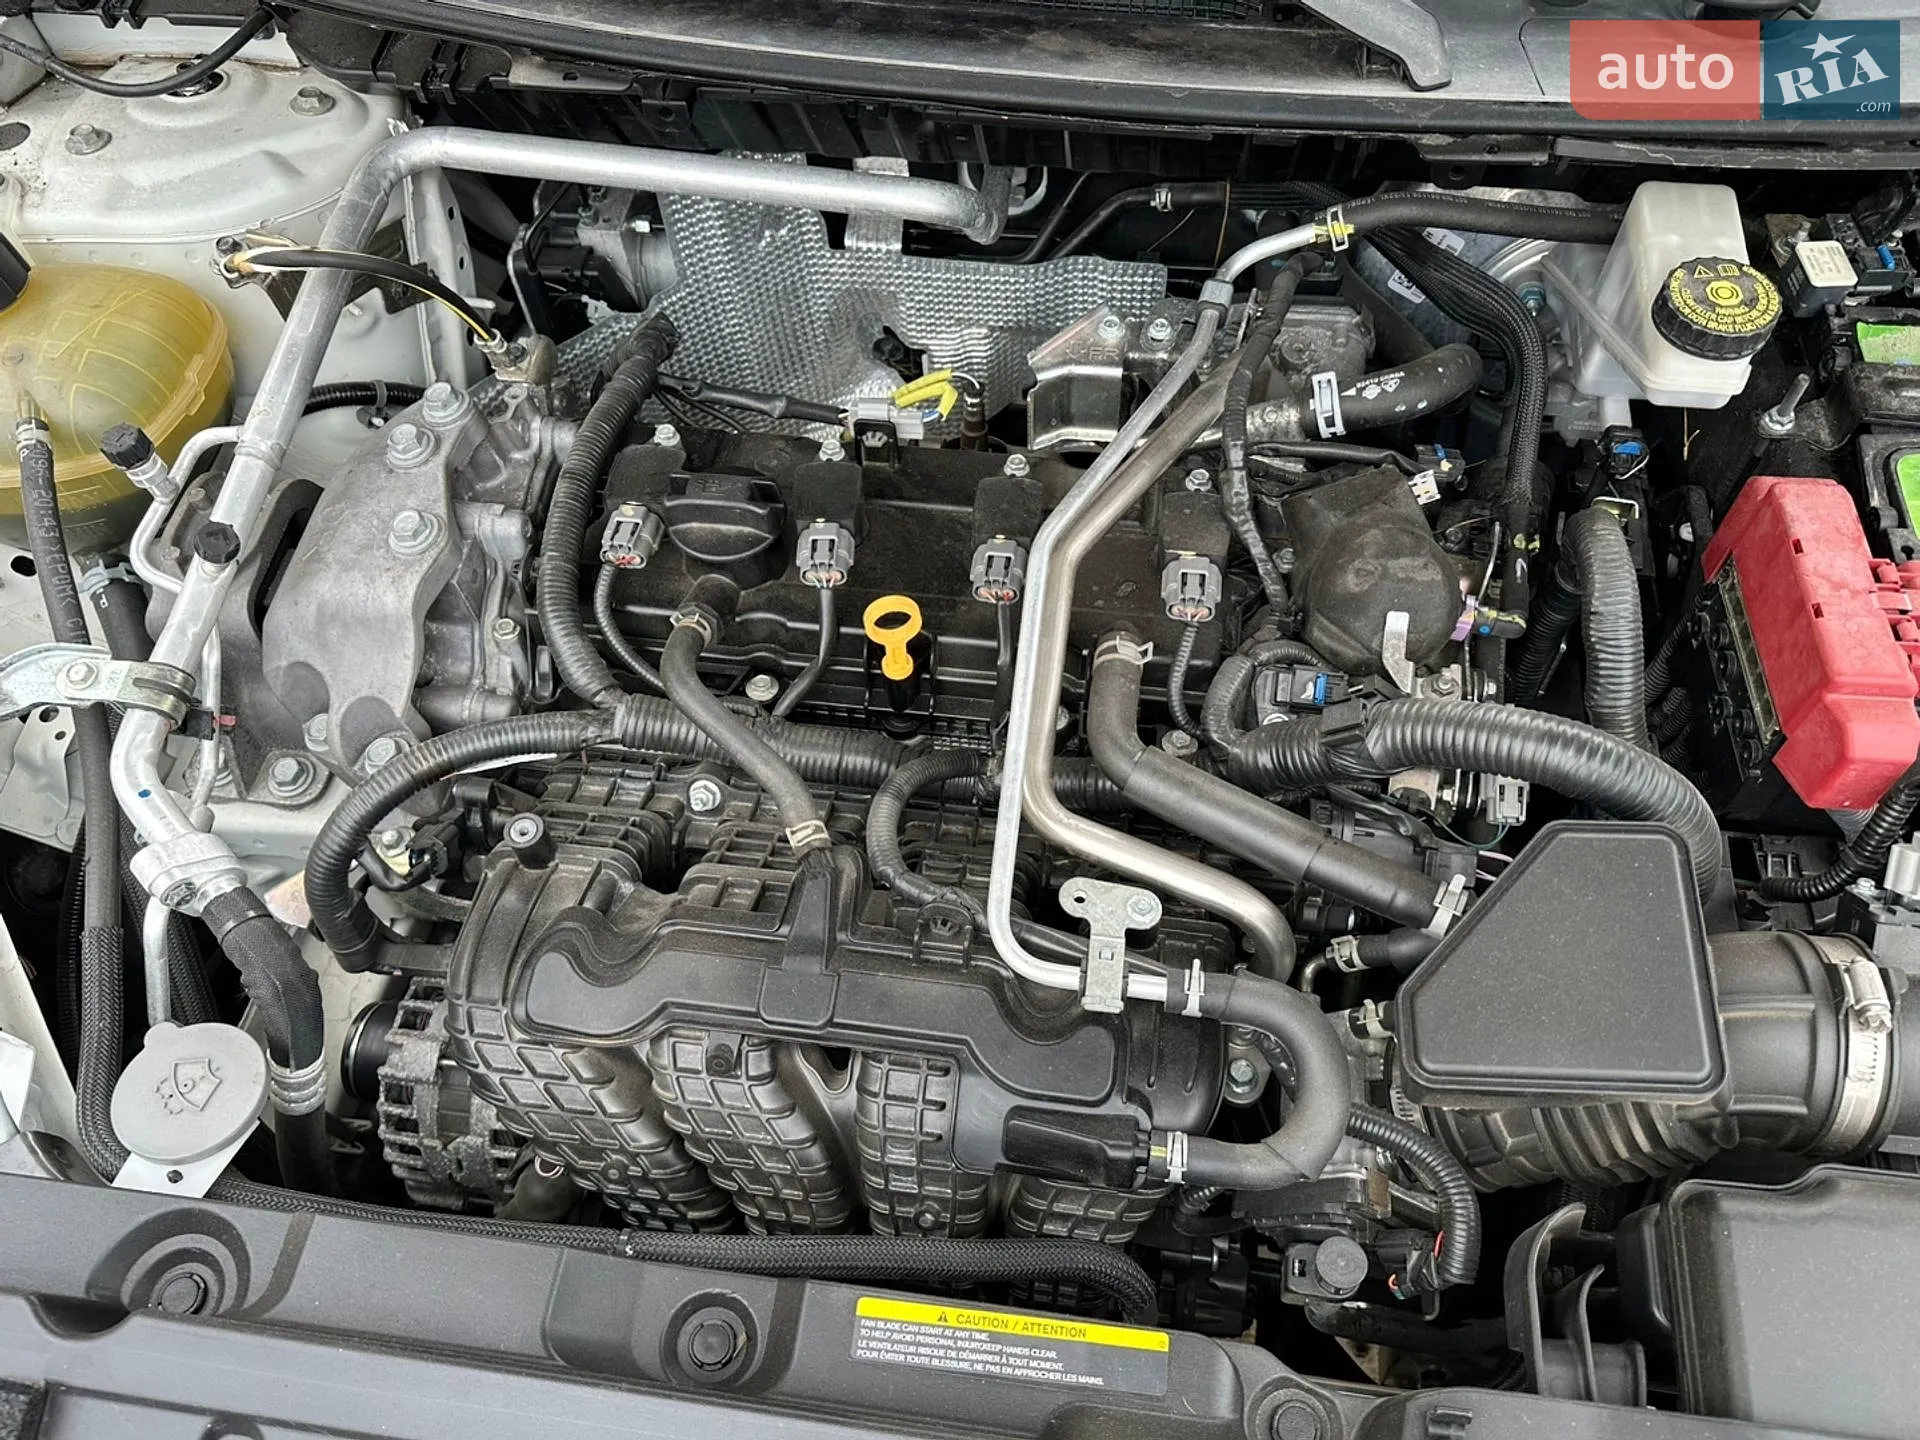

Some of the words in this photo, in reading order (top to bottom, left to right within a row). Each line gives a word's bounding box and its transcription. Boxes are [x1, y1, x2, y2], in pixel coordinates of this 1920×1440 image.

[1690, 304, 1716, 321] FILLER
[1715, 315, 1735, 323] CAP
[1733, 308, 1762, 323] BEFORE
[1715, 304, 1749, 316] WARNING
[1705, 320, 1735, 331] BRAKE
[1733, 321, 1759, 331] FLUID
[1753, 312, 1773, 327] FROM
[860, 1318, 875, 1327] FAN
[876, 1320, 901, 1330] BLADE
[902, 1323, 919, 1332] CAN
[919, 1325, 943, 1335] START
[943, 1327, 954, 1336] AT
[954, 1329, 969, 1338] ANY
[955, 1313, 1008, 1329] CAUTION
[1021, 1321, 1086, 1338] ATTENTION
[857, 1339, 868, 1347] LE
[868, 1340, 916, 1353] VENTILATEUR
[917, 1346, 946, 1356] RISQUE
[946, 1349, 957, 1357] DE
[958, 1350, 1000, 1362] DÉMARRER
[1007, 1355, 1028, 1365] TOUT
[860, 1328, 870, 1337] TO
[870, 1329, 891, 1339] HELP
[890, 1331, 914, 1341] AVOID
[1002, 1344, 1030, 1354] HANDS
[856, 1349, 878, 1359] POUR
[879, 1351, 905, 1362] ÉVITER
[906, 1354, 930, 1364] TOUTE
[973, 1362, 984, 1370] NE
[985, 1363, 1000, 1372] PAS
[1001, 1365, 1013, 1373] EN
[1013, 1366, 1061, 1379] APPROCHER
[1063, 1372, 1078, 1381] LES
